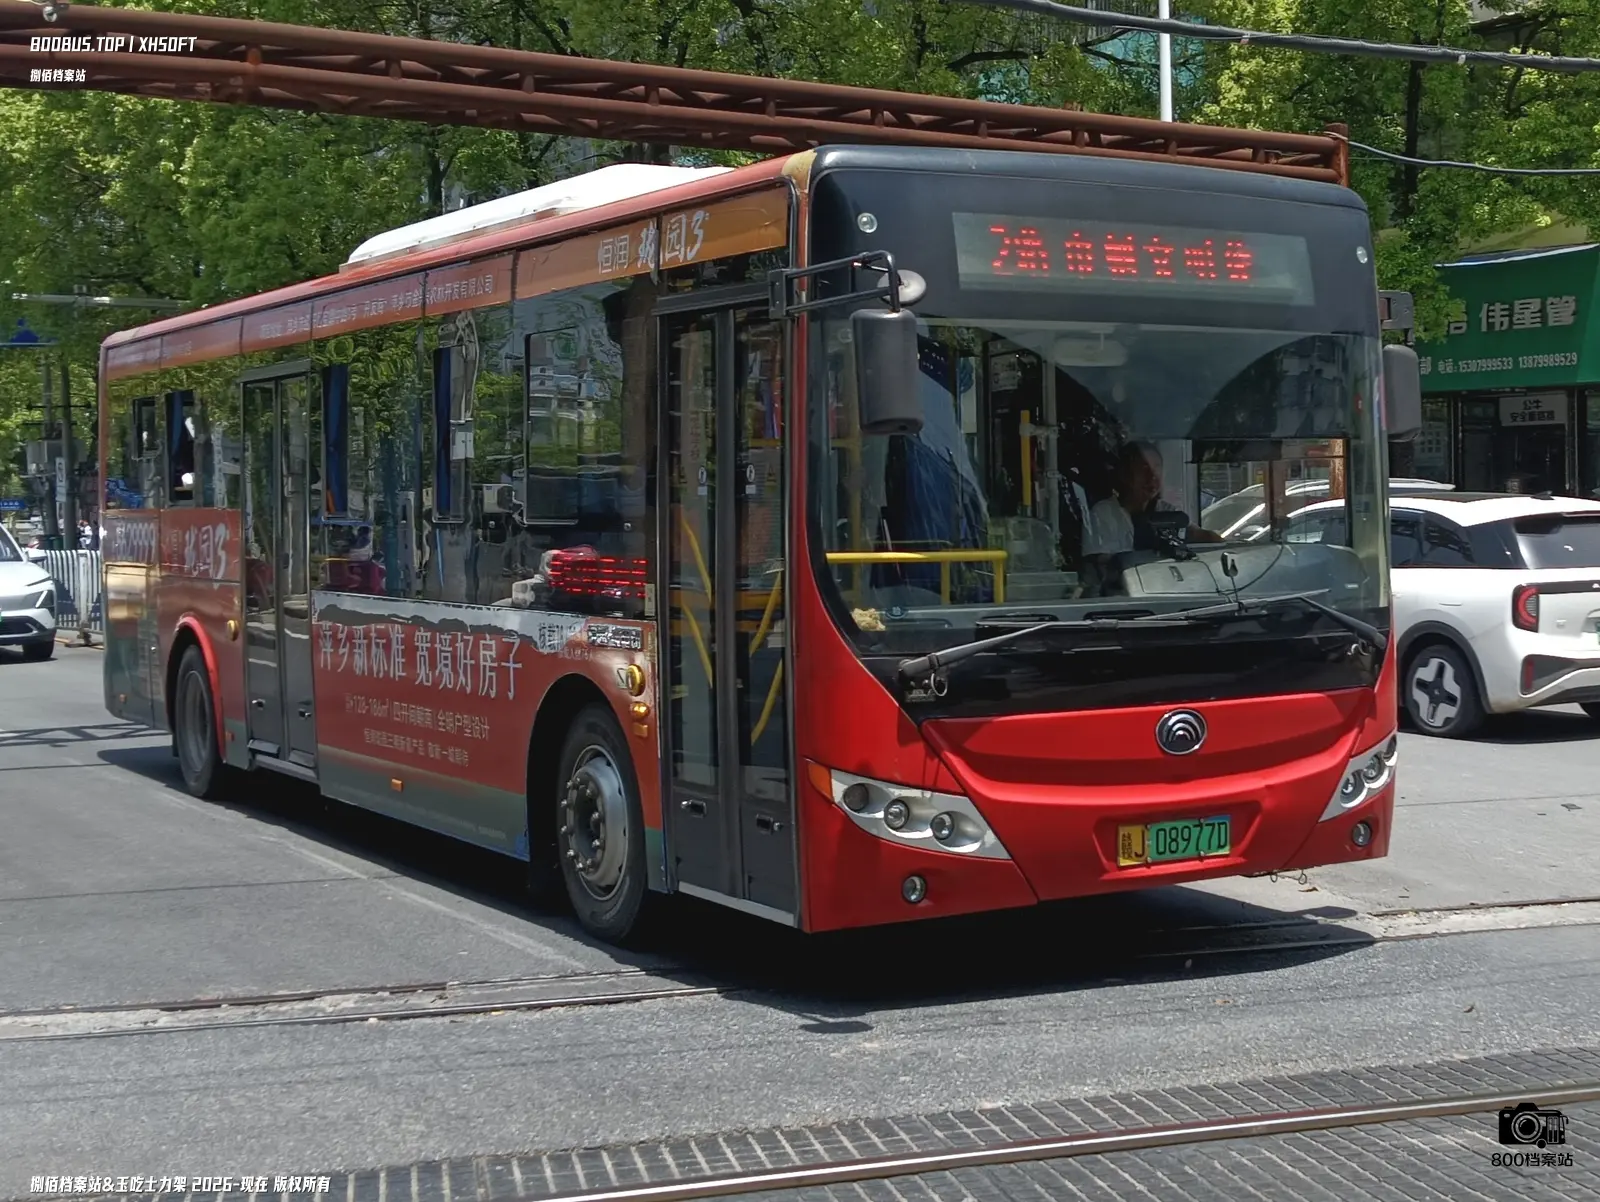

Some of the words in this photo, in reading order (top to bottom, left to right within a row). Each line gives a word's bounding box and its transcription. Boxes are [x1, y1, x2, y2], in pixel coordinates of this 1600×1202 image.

[598, 234, 629, 275] 恒润
[1479, 295, 1577, 332] 伟星管
[1518, 352, 1578, 369] 13879989529
[319, 622, 407, 681] 萍乡新标准
[414, 626, 523, 700] 宽境好房子
[1155, 821, 1228, 856] 08977D
